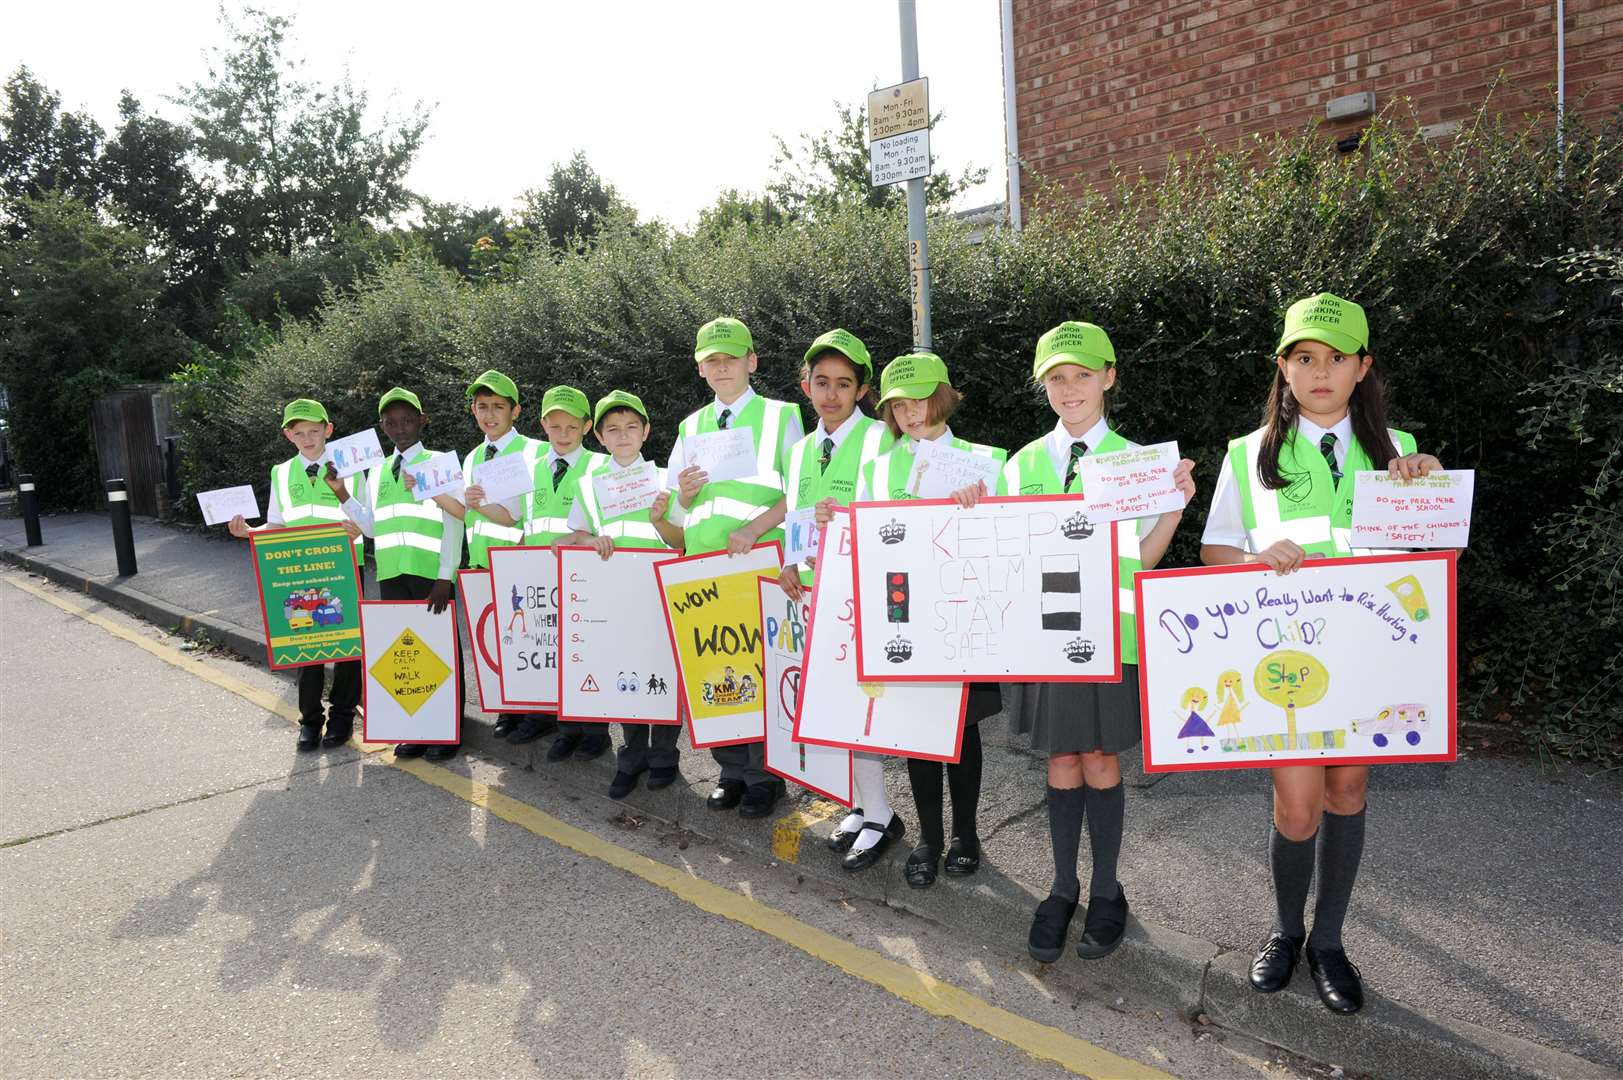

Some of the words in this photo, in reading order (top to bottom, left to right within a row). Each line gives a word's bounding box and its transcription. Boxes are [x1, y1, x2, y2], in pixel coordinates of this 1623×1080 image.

[883, 103, 899, 113] Mon
[904, 99, 912, 107] Fri
[873, 116, 889, 125] 8am
[908, 118, 924, 128] 4pm
[881, 142, 890, 150] No
[892, 136, 918, 147] loading
[884, 151, 899, 160] Mon
[906, 146, 915, 155] Fri
[875, 163, 890, 172] 8am
[909, 165, 926, 175] 4pm
[931, 512, 1058, 560] KEEP
[265, 549, 302, 560] DON'T
[305, 545, 343, 557] CROSS
[277, 565, 301, 575] THE
[304, 561, 336, 572] LINE!
[940, 558, 1024, 595] CALM
[526, 585, 546, 609] BE
[674, 581, 719, 614] WOW
[534, 614, 557, 627] WHEN
[934, 600, 1013, 633] STAY
[1159, 609, 1199, 654] Do
[1206, 600, 1249, 639] you
[1255, 587, 1299, 616] Really
[1301, 588, 1334, 604] Want
[1339, 587, 1354, 602] to
[1376, 603, 1407, 641] Hurting
[766, 616, 806, 653] PAR
[944, 632, 999, 660] SAFE
[394, 671, 420, 680] WALK
[395, 683, 437, 696] WEDNESDAY
[714, 684, 731, 693] KM
